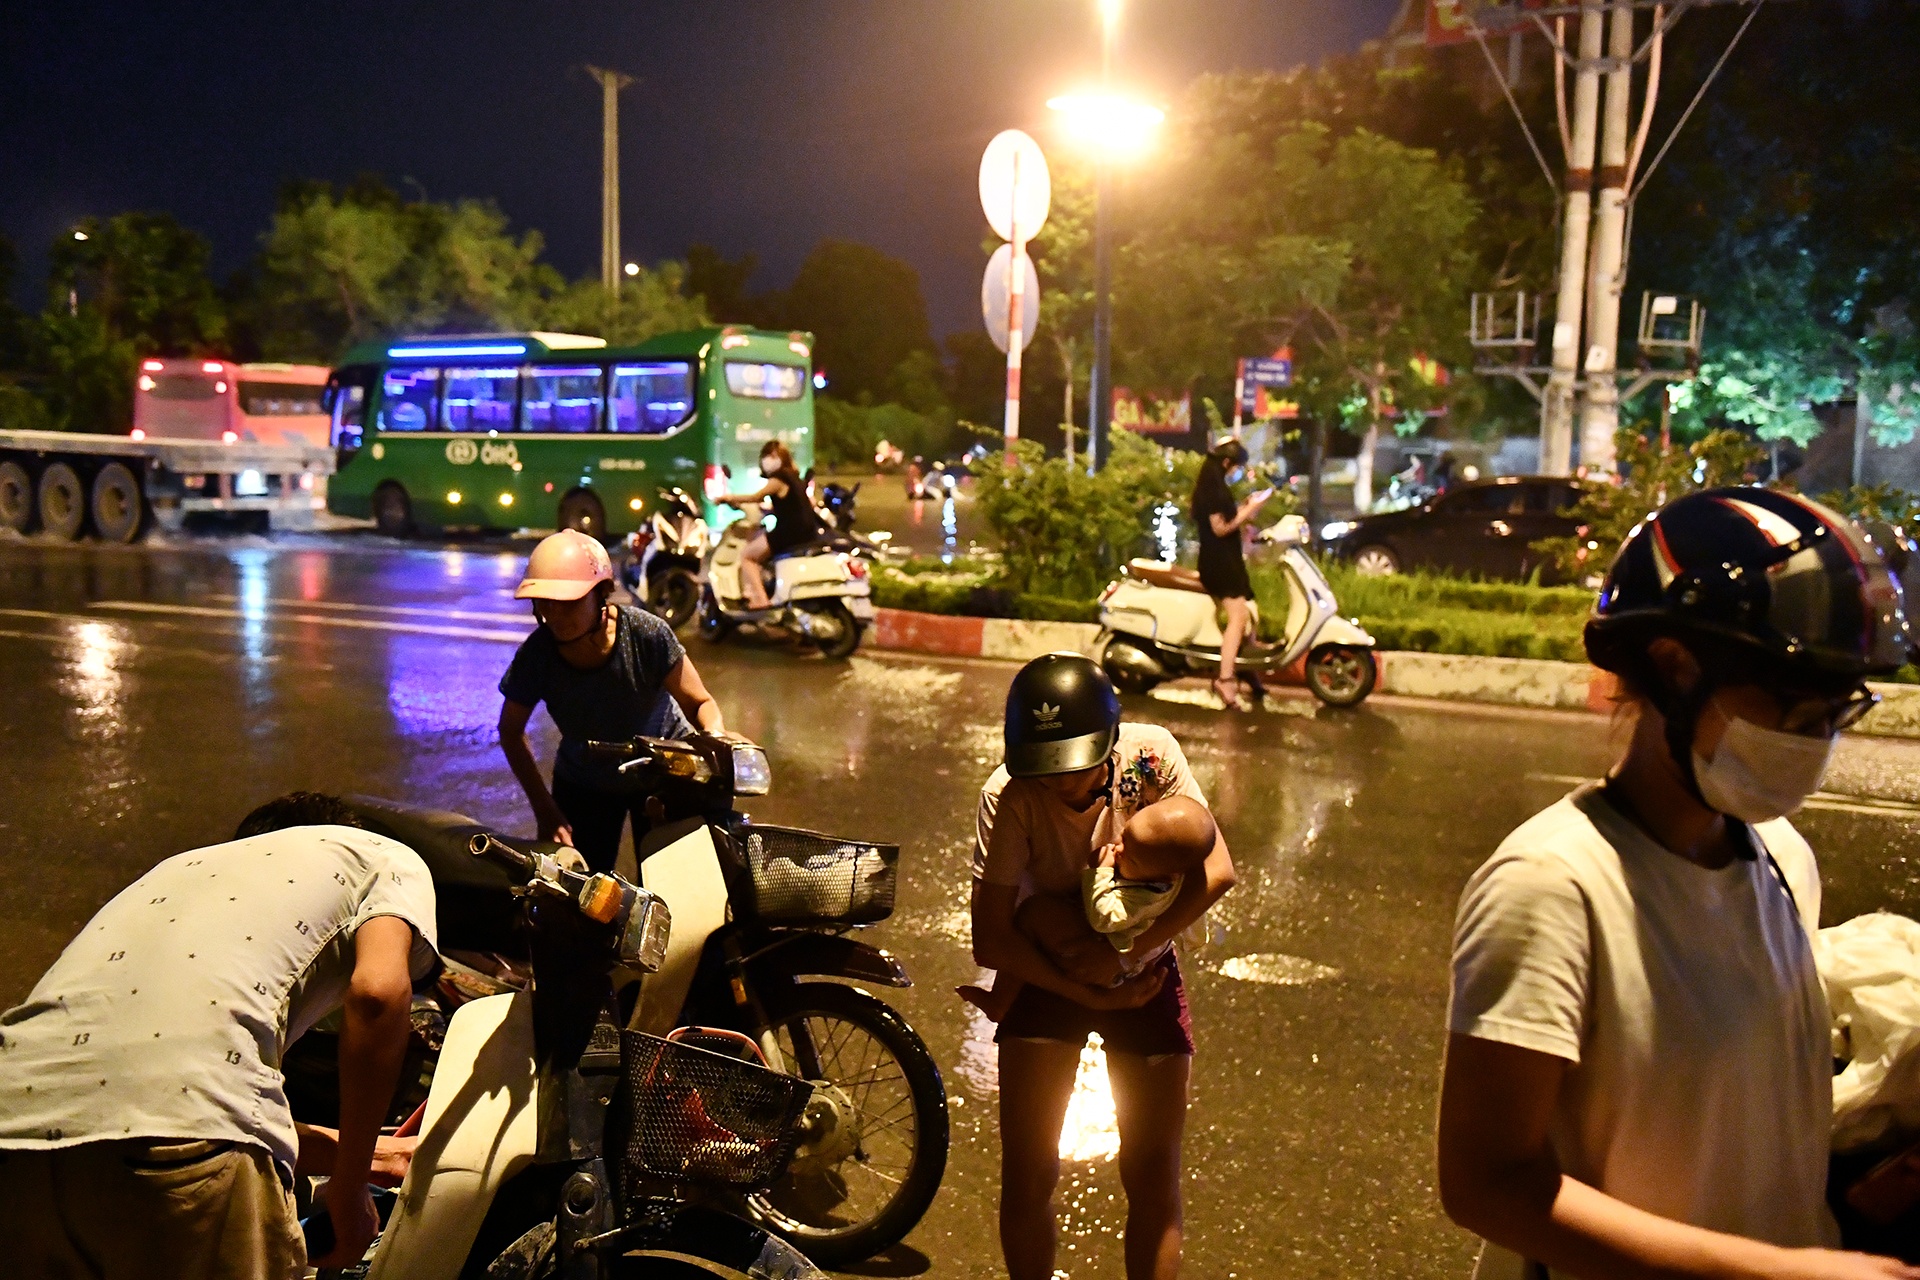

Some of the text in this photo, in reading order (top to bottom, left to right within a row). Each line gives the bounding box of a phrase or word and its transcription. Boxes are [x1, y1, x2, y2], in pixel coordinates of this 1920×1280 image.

[1035, 721, 1062, 731] adidas
[333, 872, 347, 886] 13
[391, 872, 402, 886] 13
[149, 897, 167, 905] 13
[295, 920, 309, 935] 13
[107, 951, 126, 962] 13
[254, 981, 267, 996] 13
[72, 1033, 90, 1046] 13
[225, 1050, 242, 1065] 13
